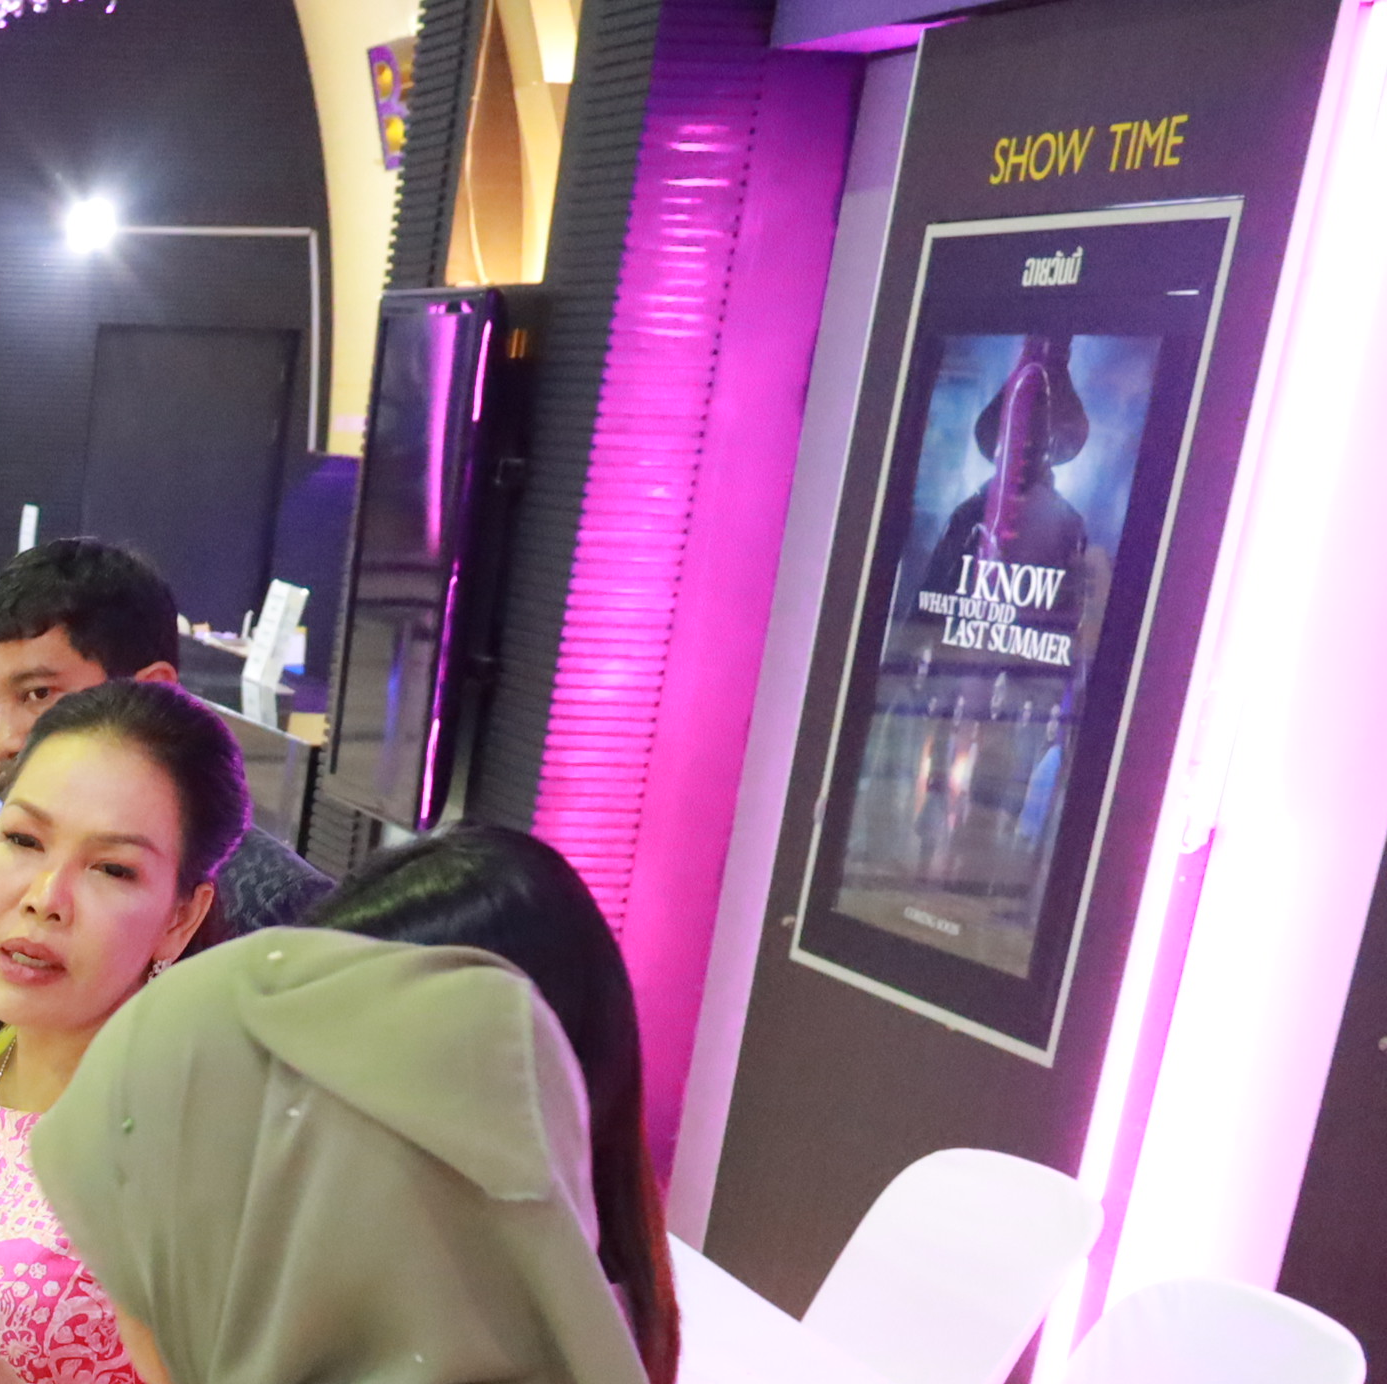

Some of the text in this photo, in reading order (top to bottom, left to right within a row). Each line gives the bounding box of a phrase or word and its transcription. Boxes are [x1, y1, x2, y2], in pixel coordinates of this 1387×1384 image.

[989, 114, 1189, 185] SHOW TIME
[1021, 246, 1084, 288] ฉายวันนี้
[919, 590, 1017, 625] WHAT YOU DID
[955, 554, 1067, 611] I KNOW
[941, 616, 1072, 667] LAST SUMMER
